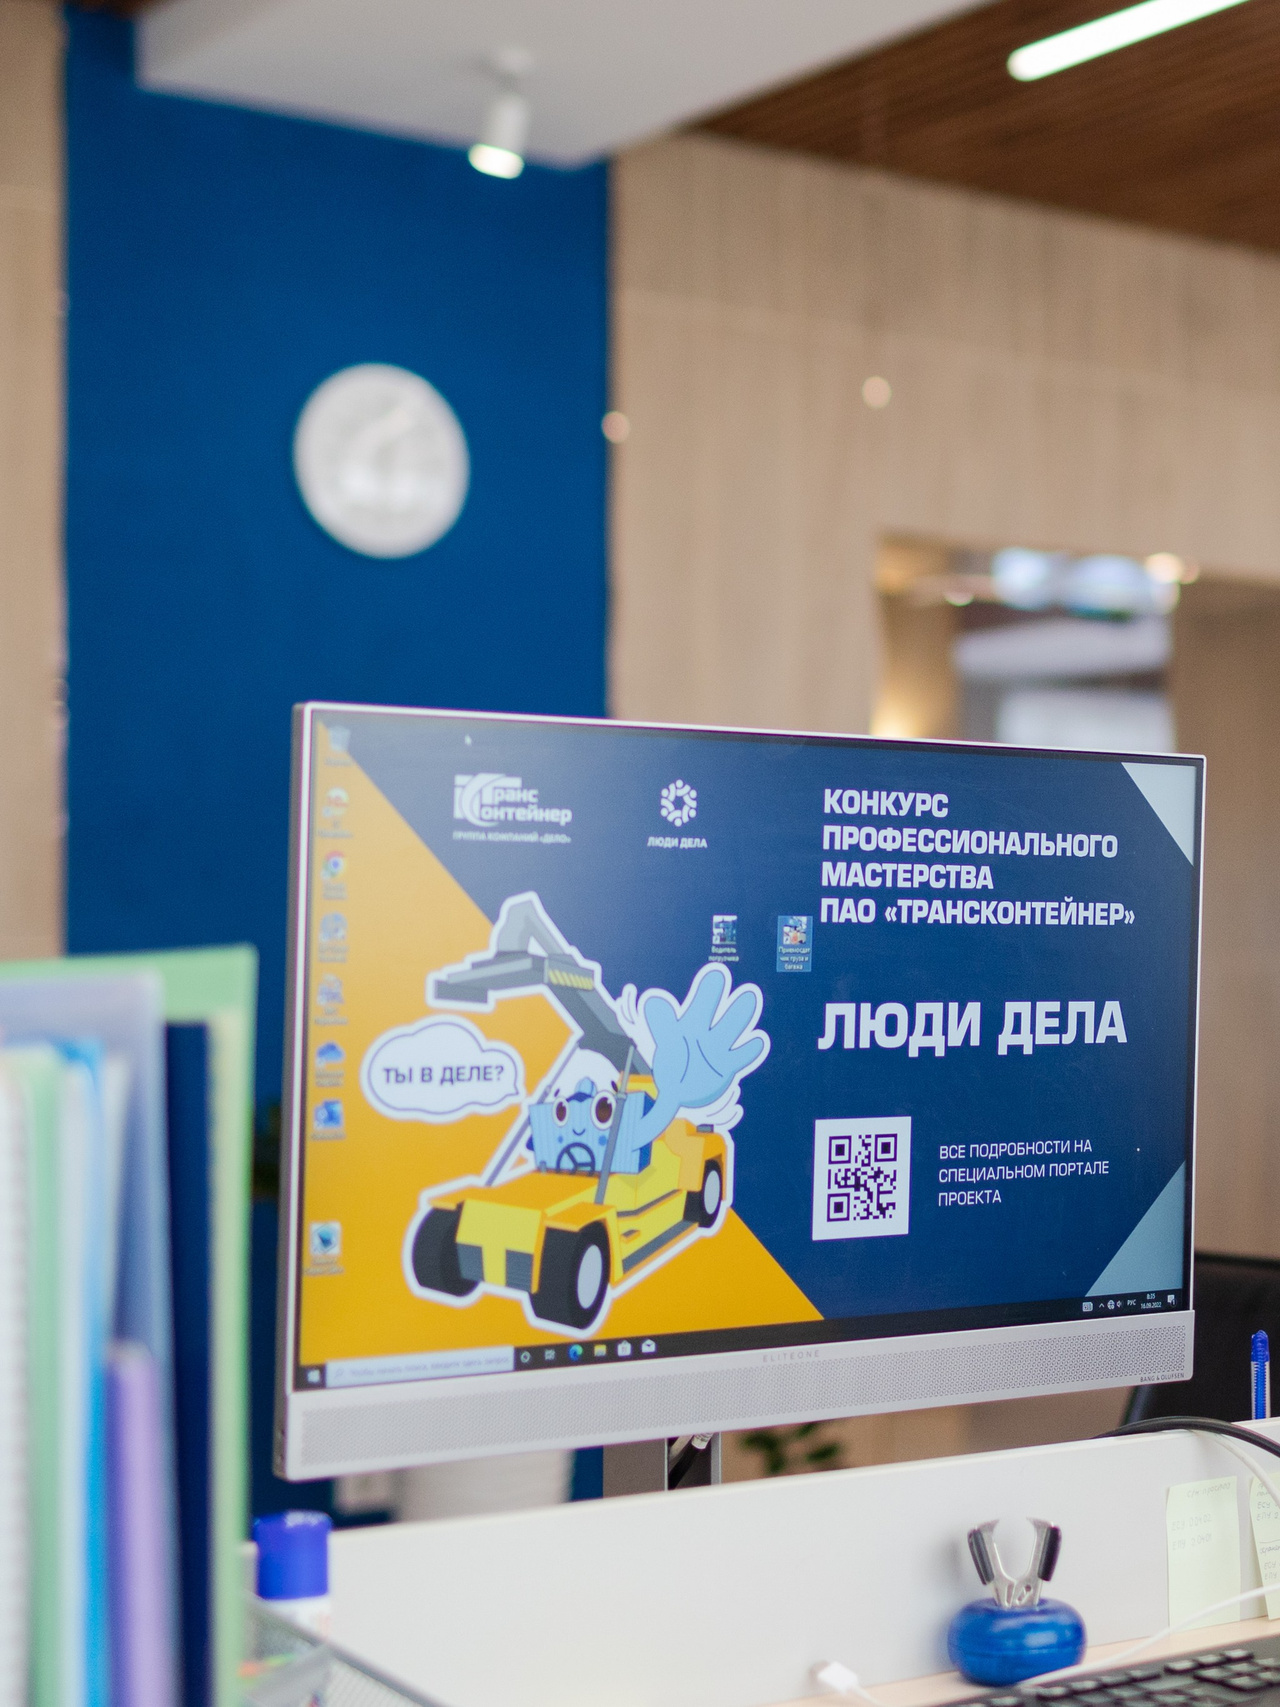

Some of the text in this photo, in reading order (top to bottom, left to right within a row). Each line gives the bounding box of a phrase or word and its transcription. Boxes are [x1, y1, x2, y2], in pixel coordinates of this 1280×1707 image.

[824, 788, 948, 817] КОНКУРС
[647, 837, 708, 849] ЛЮДИ ДЕЛА
[823, 825, 1118, 857] ПРОФЕССИОНАЛЬНОГО
[822, 862, 994, 889] МАСТЕРСТВА
[820, 896, 1135, 925] ПАО «ТРАНСКОНТЕЙНЕР»
[818, 1001, 1127, 1057] ЛЮДИ ДЕЛА
[384, 1065, 504, 1085] ТЫ В ДЕЛЕ?
[940, 1140, 1092, 1159] ВСЕ ПОДРОБНОСТИ НА
[939, 1161, 1109, 1184] СПЕЦИАЛЬНОМ ПОРТАЛЕ
[938, 1190, 1001, 1206] ПРОЕКТА
[763, 1349, 820, 1362] ELITEONE
[1161, 1373, 1184, 1381] OLUFSEN
